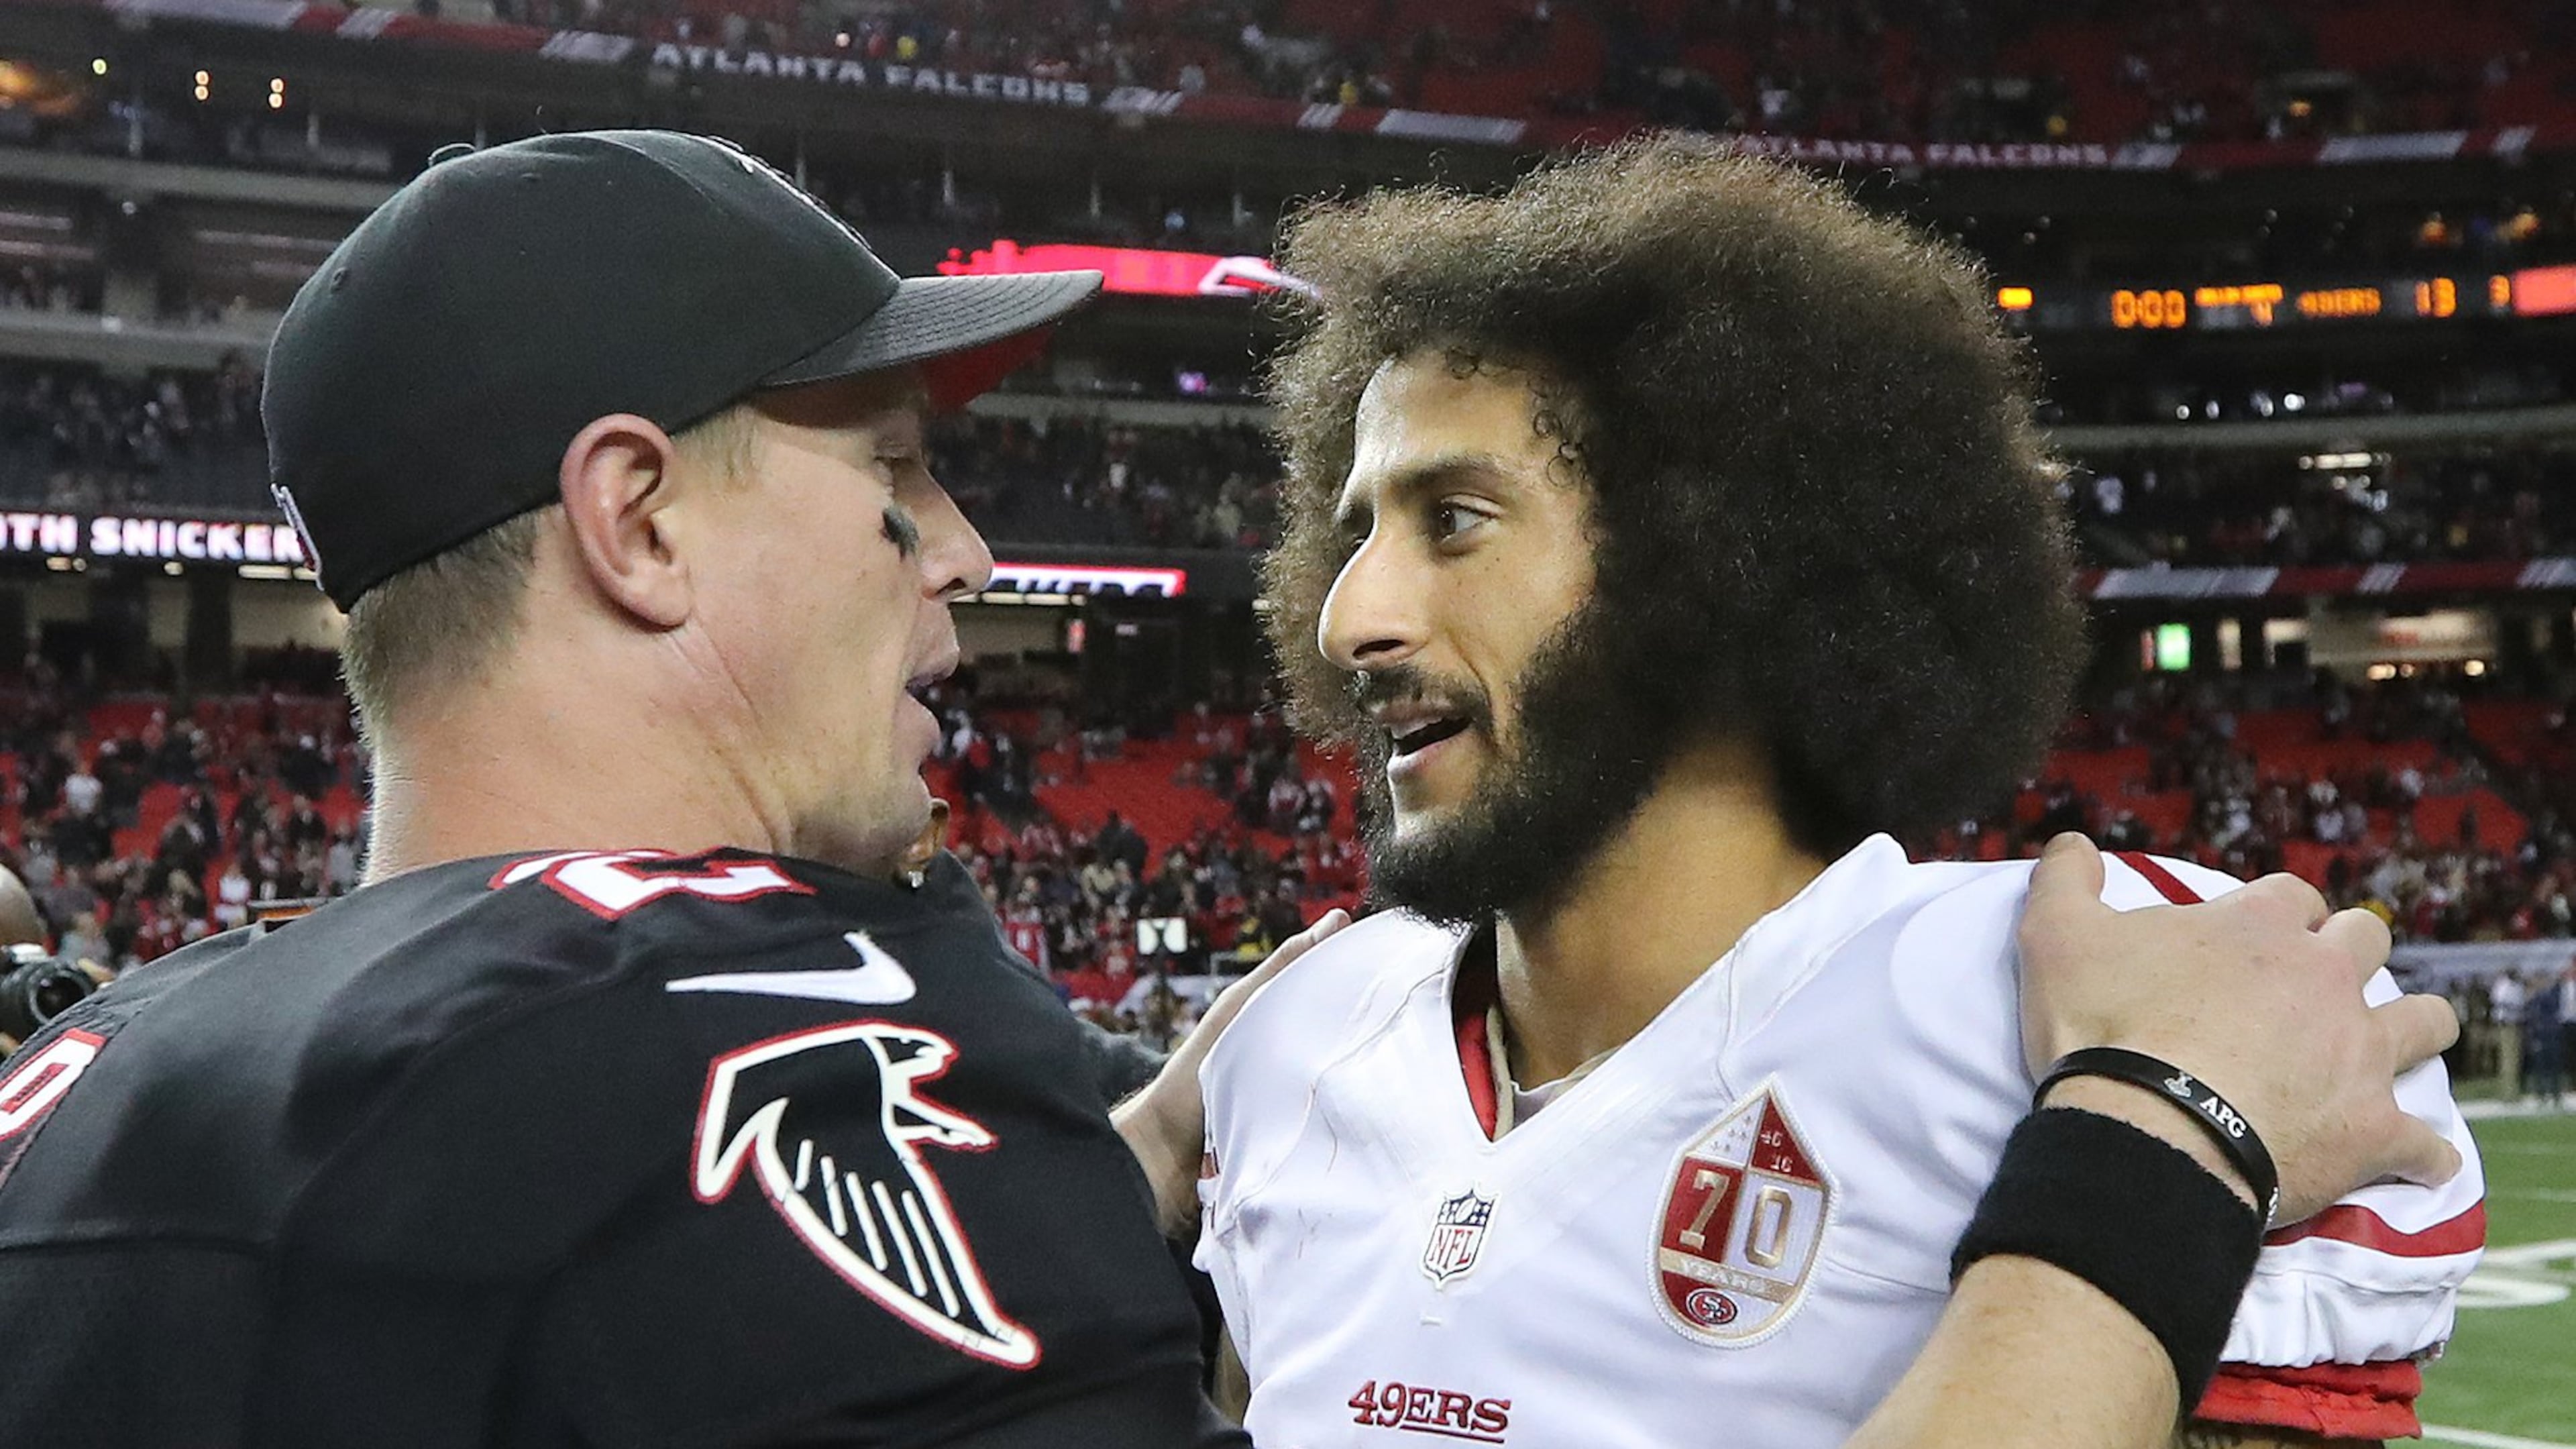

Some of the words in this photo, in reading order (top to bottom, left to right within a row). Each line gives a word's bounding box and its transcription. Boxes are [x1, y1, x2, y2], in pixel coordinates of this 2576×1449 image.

[653, 43, 865, 82] ATLANTA
[885, 66, 1090, 104] FALCONS
[1929, 142, 2107, 167] FALCONS
[2199, 1096, 2248, 1139] APG
[1680, 1170, 1792, 1267] 70
[1429, 1227, 1474, 1270] NFL
[1680, 1258, 1766, 1294] YEARS
[1348, 1379, 1512, 1434] 49ERS
